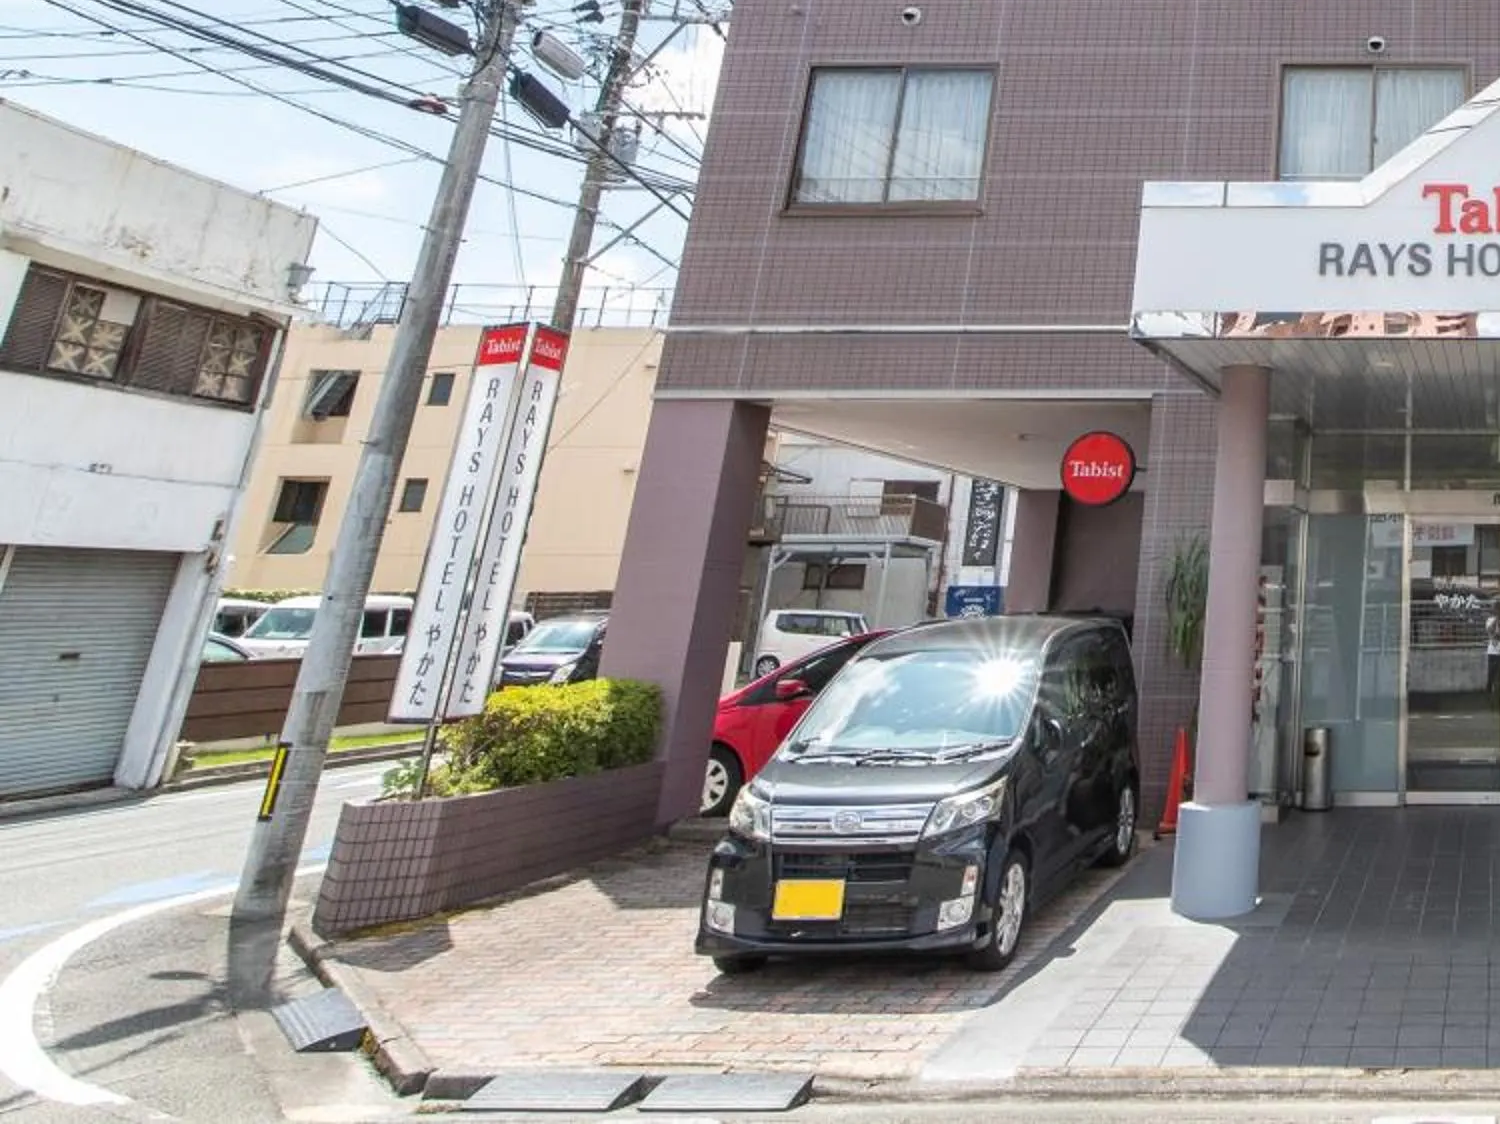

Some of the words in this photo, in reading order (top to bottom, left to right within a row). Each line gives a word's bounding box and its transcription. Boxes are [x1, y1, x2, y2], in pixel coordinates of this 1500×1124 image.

[1318, 243, 1433, 278] RAYS
[486, 337, 521, 355] Tabist
[535, 337, 561, 359] Tabist
[469, 378, 499, 474] RAYS
[515, 381, 544, 475] RAYS
[1069, 460, 1124, 479] Tabist
[435, 485, 474, 612] HOTEL
[482, 489, 519, 611] HOTEL
[1434, 593, 1480, 610] やかた
[408, 625, 441, 706] やかた
[459, 623, 487, 704] やかた
